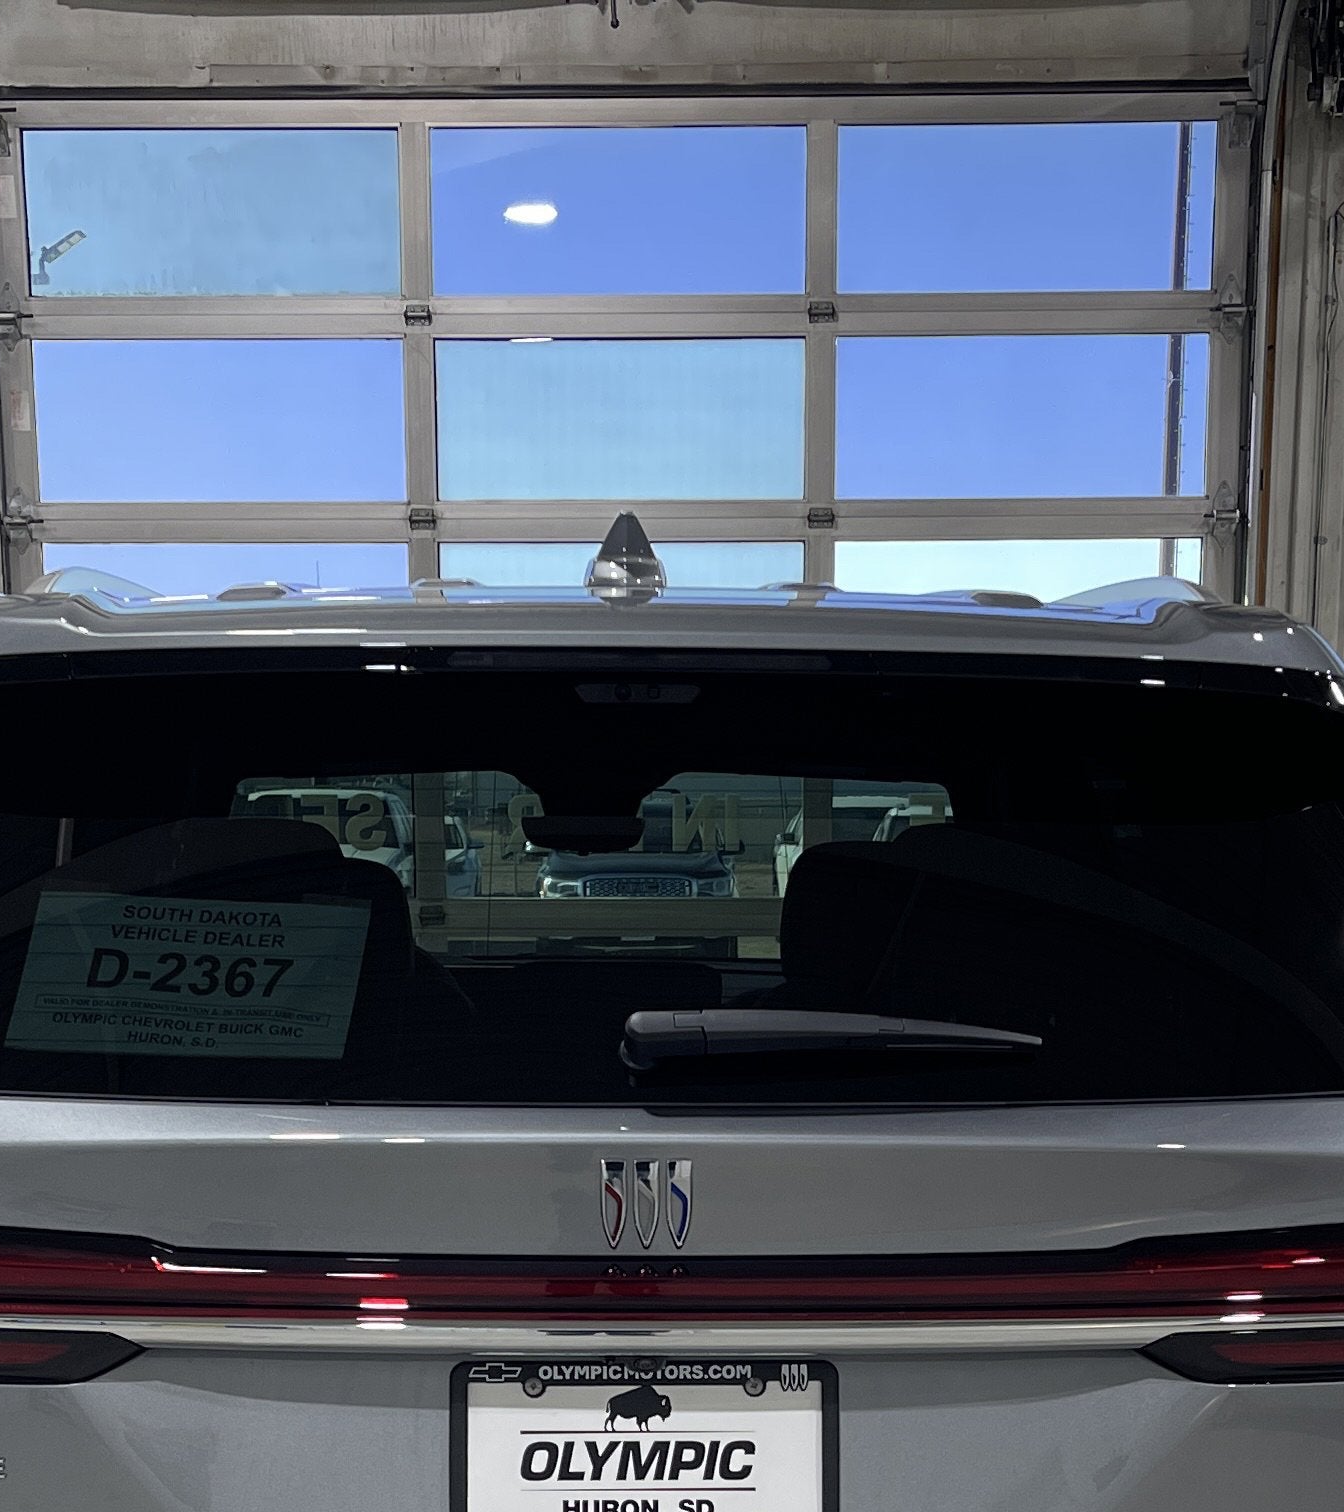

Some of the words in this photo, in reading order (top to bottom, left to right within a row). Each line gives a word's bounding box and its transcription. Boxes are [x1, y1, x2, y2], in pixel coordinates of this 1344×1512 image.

[123, 905, 194, 923] SOUTH
[199, 909, 282, 928] DAKOTA
[111, 925, 198, 944] VEHICLE
[203, 931, 285, 949] DEALER
[86, 947, 294, 998] D-2367
[92, 1000, 127, 1009] DEALER
[52, 1011, 118, 1025] OLYMPIC
[121, 1015, 215, 1033] CHEVROLET
[218, 1022, 265, 1035] BUICK
[269, 1025, 304, 1039] GMC
[520, 1440, 756, 1481] OLYMPIC
